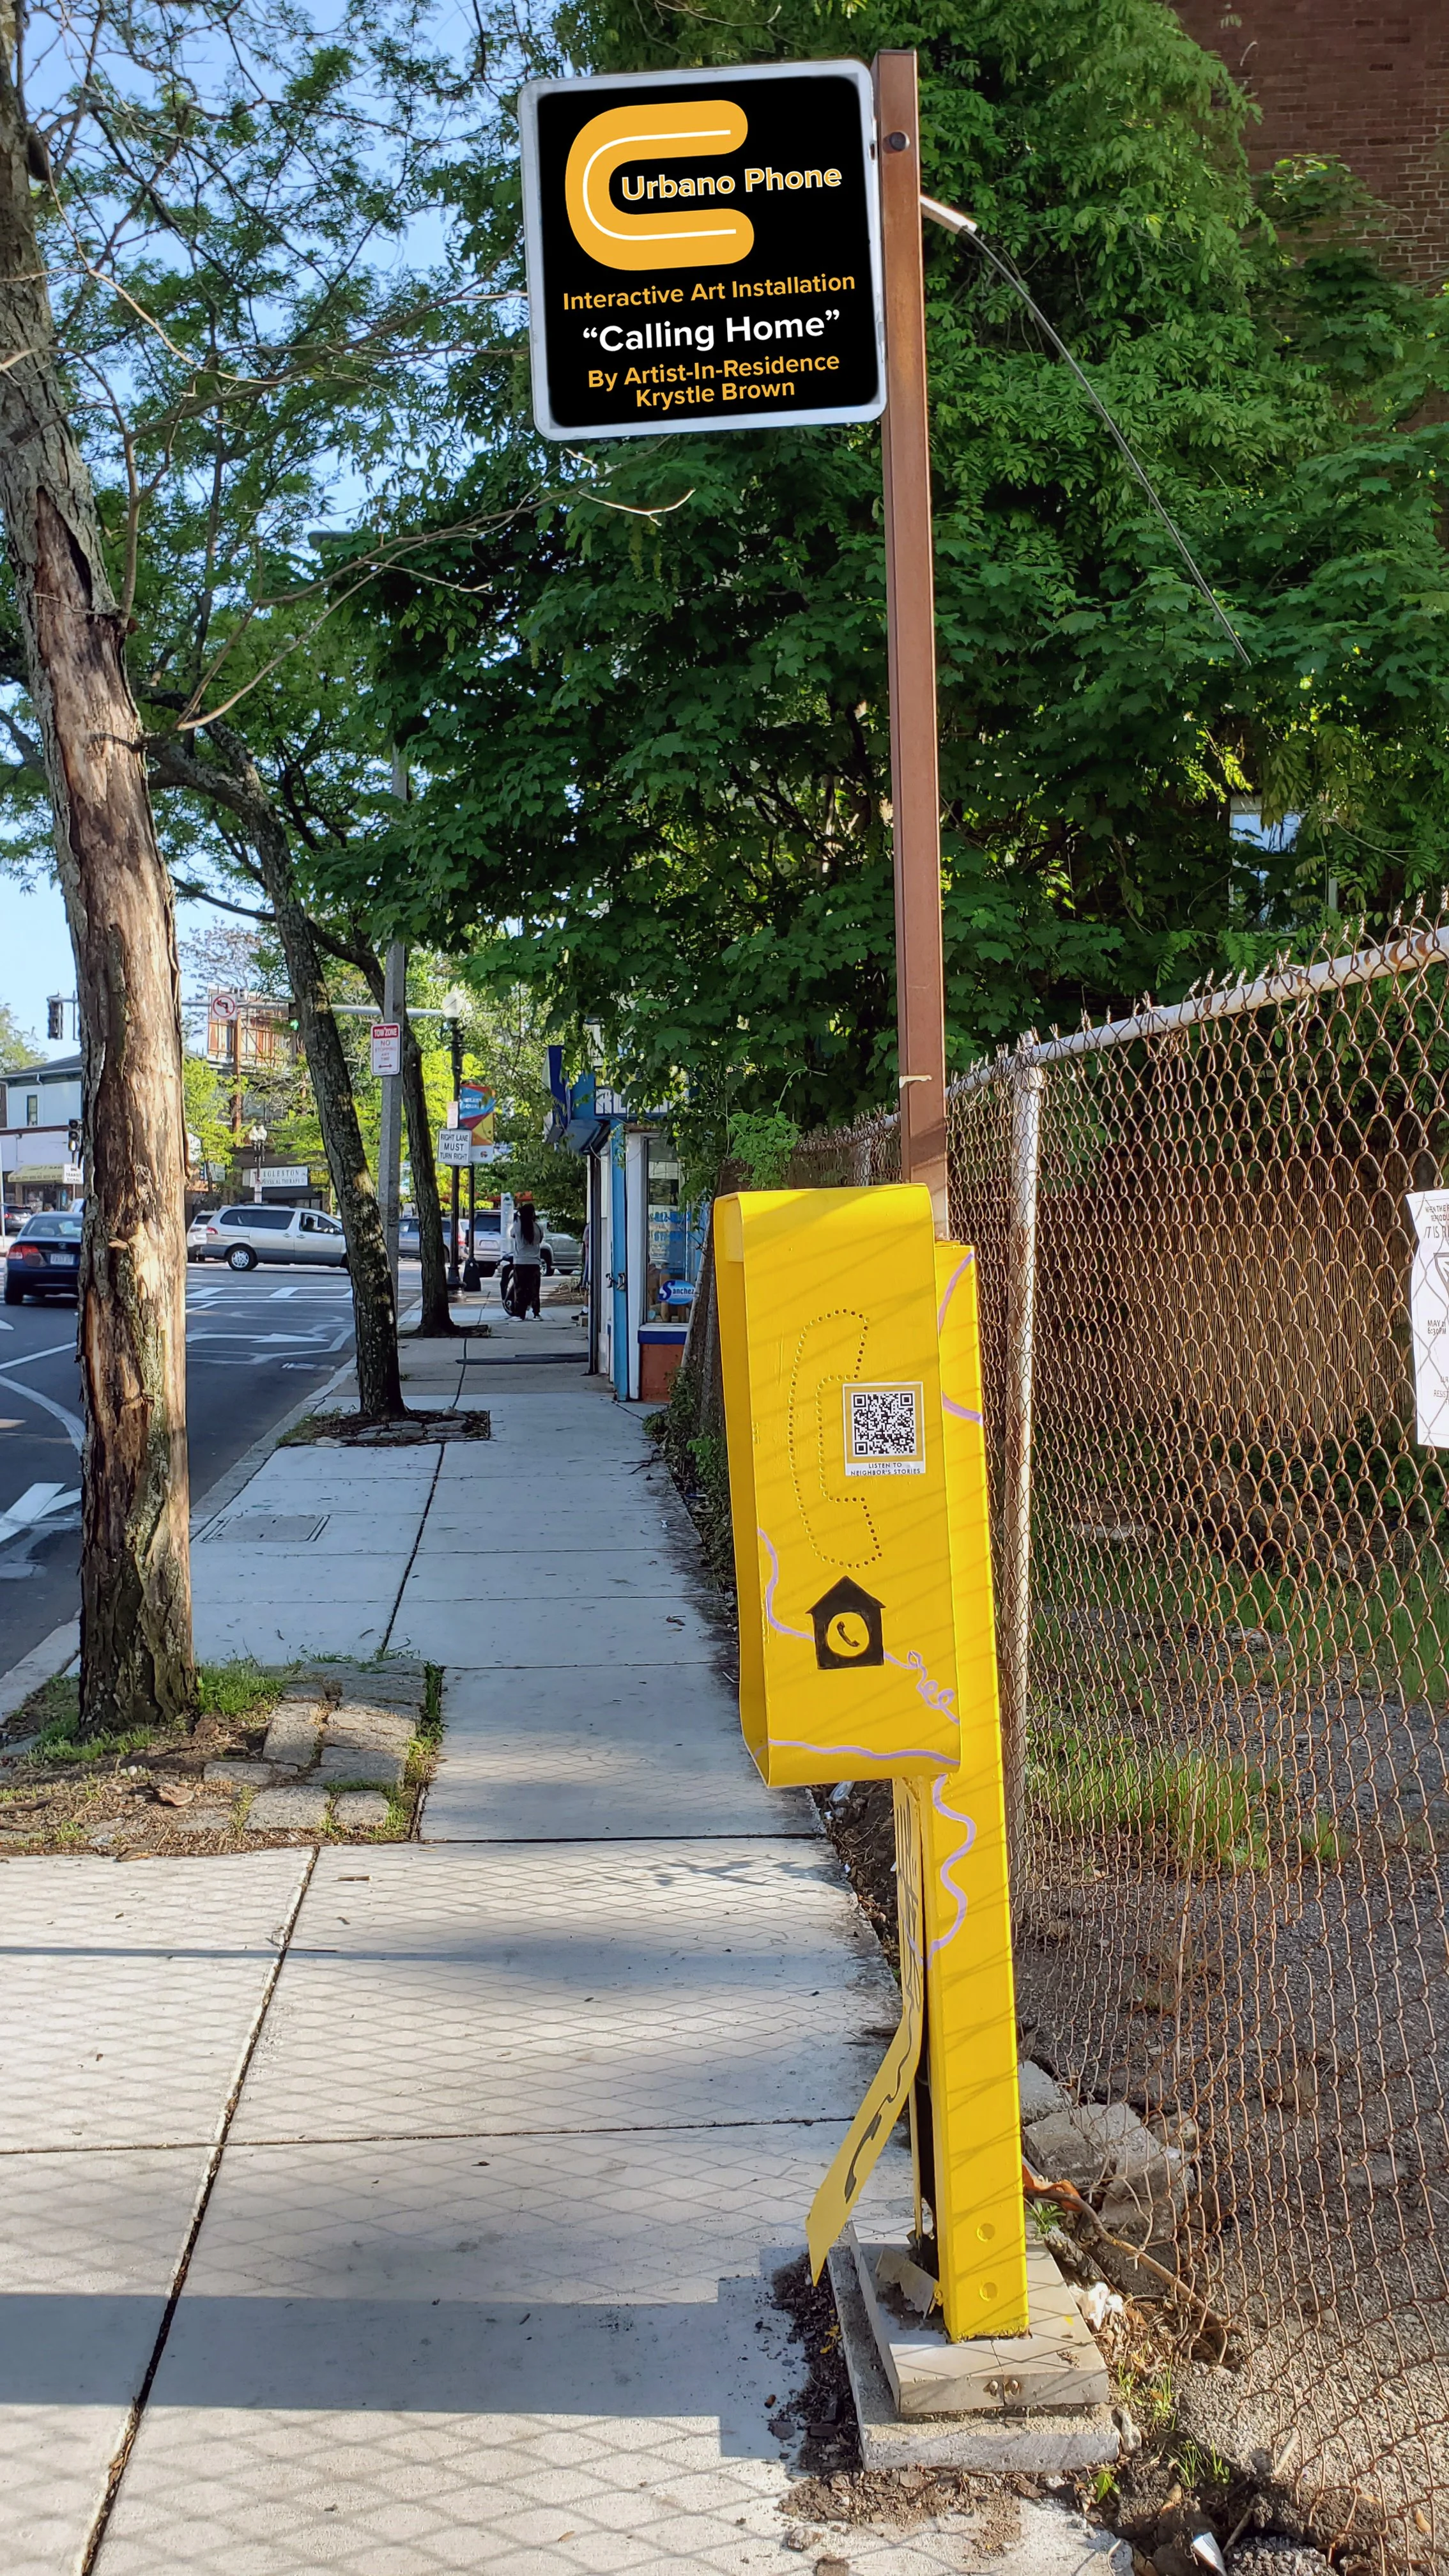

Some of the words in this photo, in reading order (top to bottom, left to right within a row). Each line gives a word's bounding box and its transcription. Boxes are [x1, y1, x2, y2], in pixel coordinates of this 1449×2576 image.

[622, 174, 735, 201] Urbano
[744, 167, 842, 192] Phone
[563, 285, 684, 310] Interactive
[691, 282, 726, 301] Art
[732, 273, 855, 298] Installation
[583, 321, 714, 351] “Calling
[726, 309, 840, 342] Home”
[588, 370, 618, 392] By
[624, 355, 840, 385] Artist-In-Residence
[636, 385, 715, 410] Krystle
[722, 381, 795, 401] Brown
[374, 1029, 385, 1037] TOW
[385, 1027, 397, 1036] ZONE
[1433, 1226, 1439, 1238] IS
[659, 1280, 694, 1301] Sanchez
